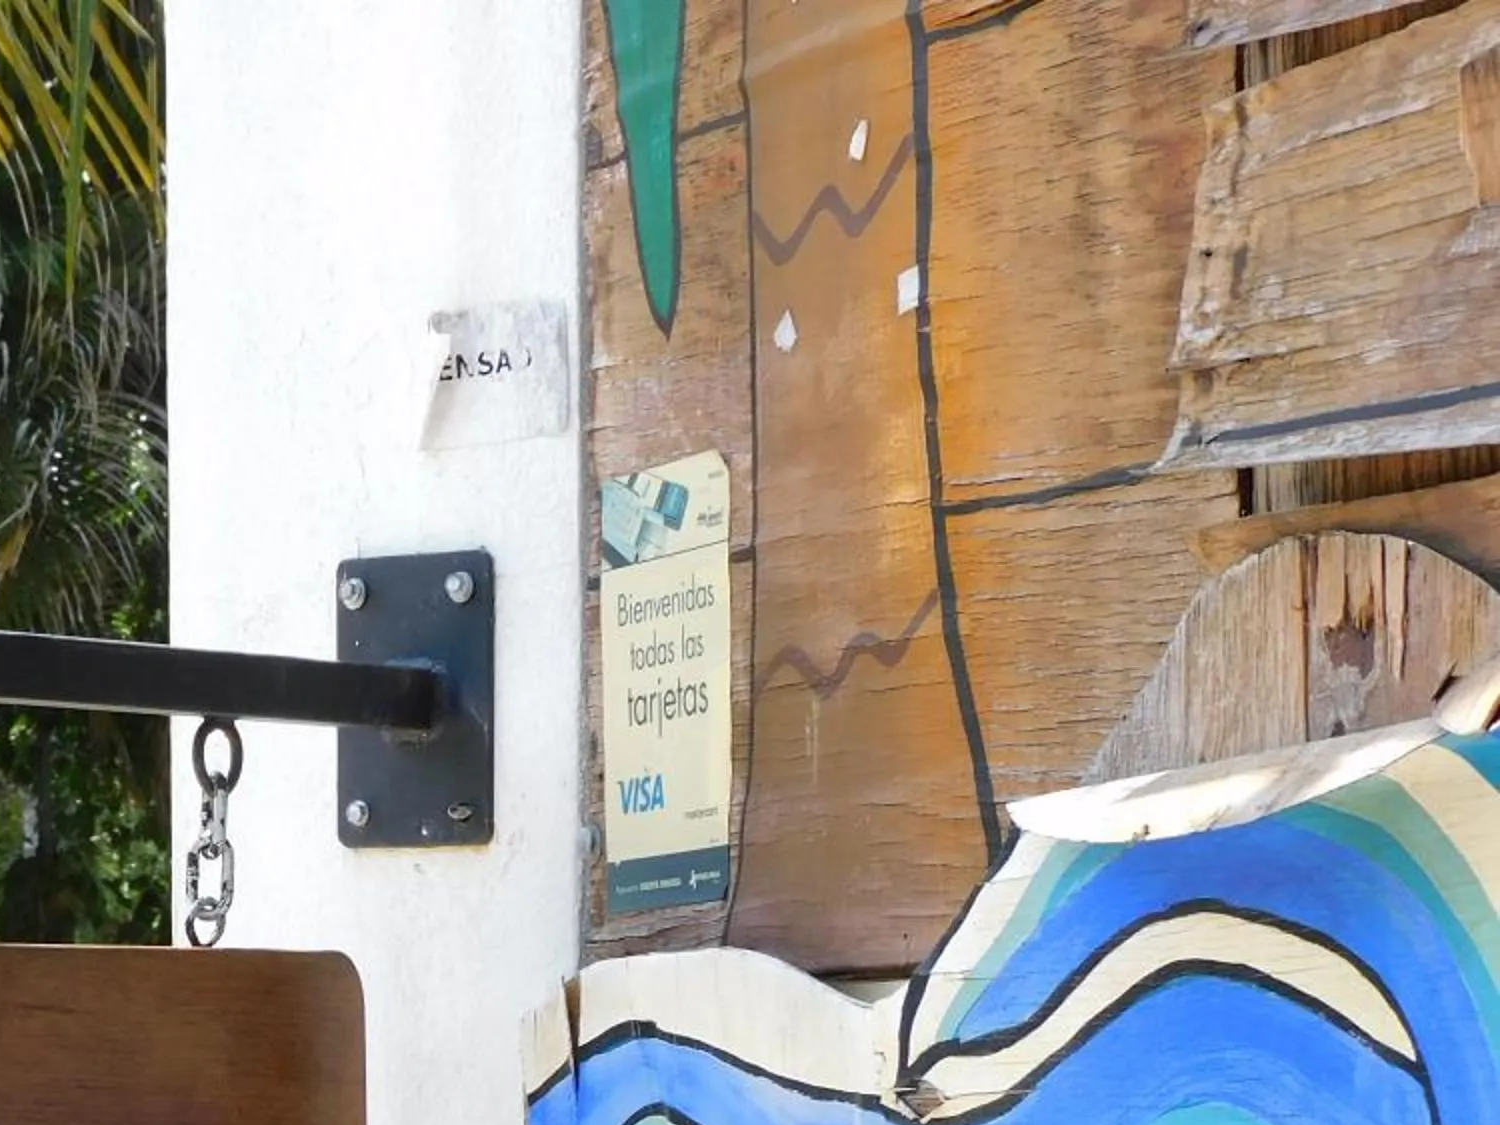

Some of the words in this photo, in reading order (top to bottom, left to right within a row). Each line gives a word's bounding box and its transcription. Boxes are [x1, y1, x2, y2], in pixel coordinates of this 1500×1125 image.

[617, 573, 715, 627] Bienvenidas
[630, 629, 674, 671] todas
[682, 623, 704, 661] las
[628, 677, 708, 737] tarjetas
[617, 773, 665, 814] VISA
